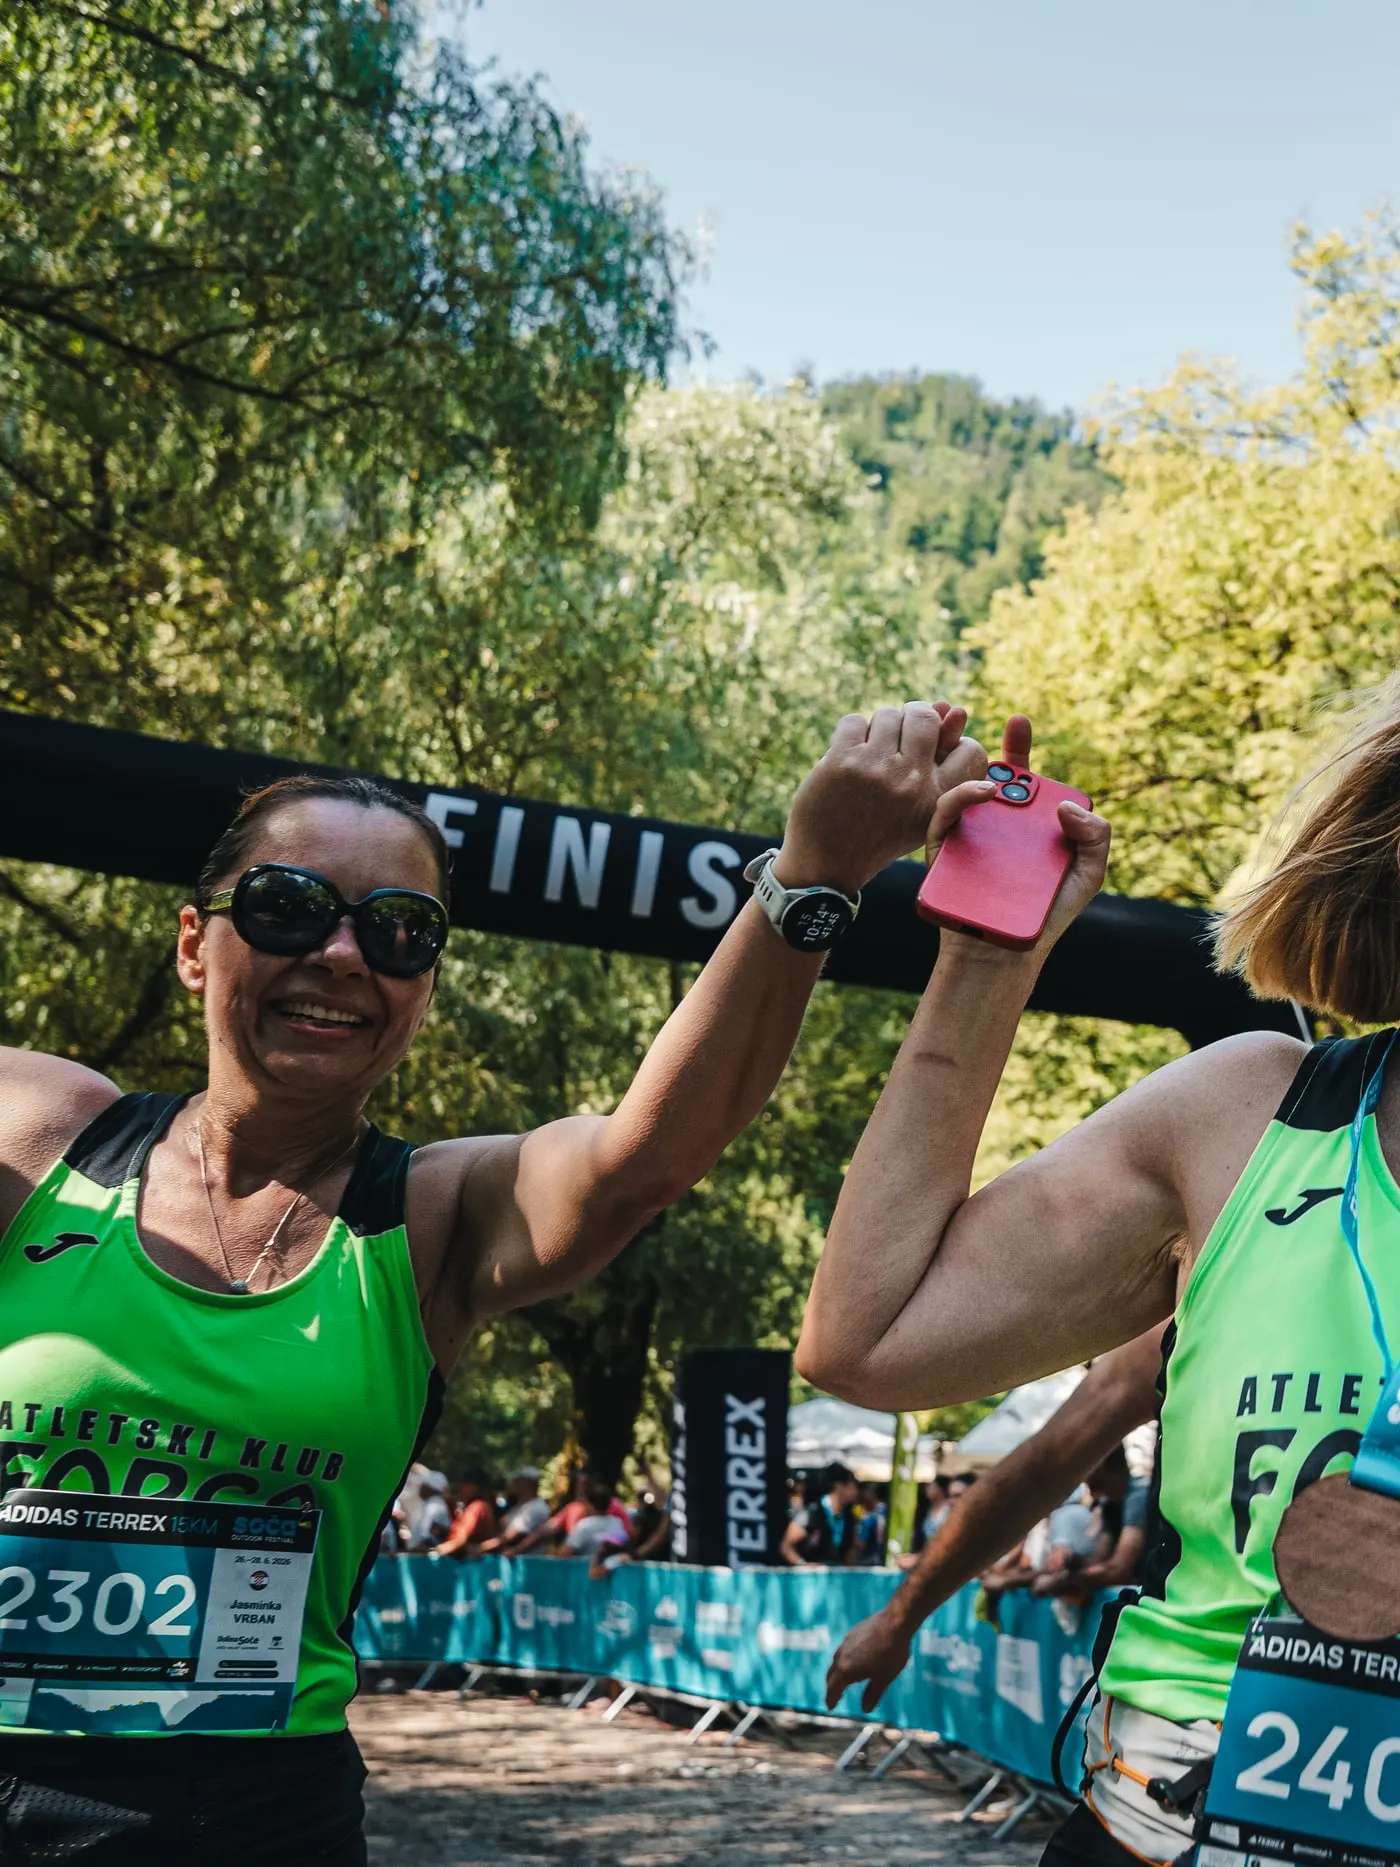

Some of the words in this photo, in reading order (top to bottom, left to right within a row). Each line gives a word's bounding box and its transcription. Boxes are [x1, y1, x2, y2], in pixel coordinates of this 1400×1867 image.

[422, 792, 742, 929] FINIS
[0, 1400, 217, 1460] ATLETSKI
[238, 1437, 344, 1482] KLUB
[0, 1505, 78, 1526] ADIDAS
[83, 1511, 168, 1532] TERREX
[171, 1516, 218, 1535] 15KM
[0, 1565, 197, 1636] 2302
[230, 1599, 282, 1611] Jasminka
[233, 1613, 276, 1625] VRBAN
[1248, 1634, 1344, 1670] ADIDAS
